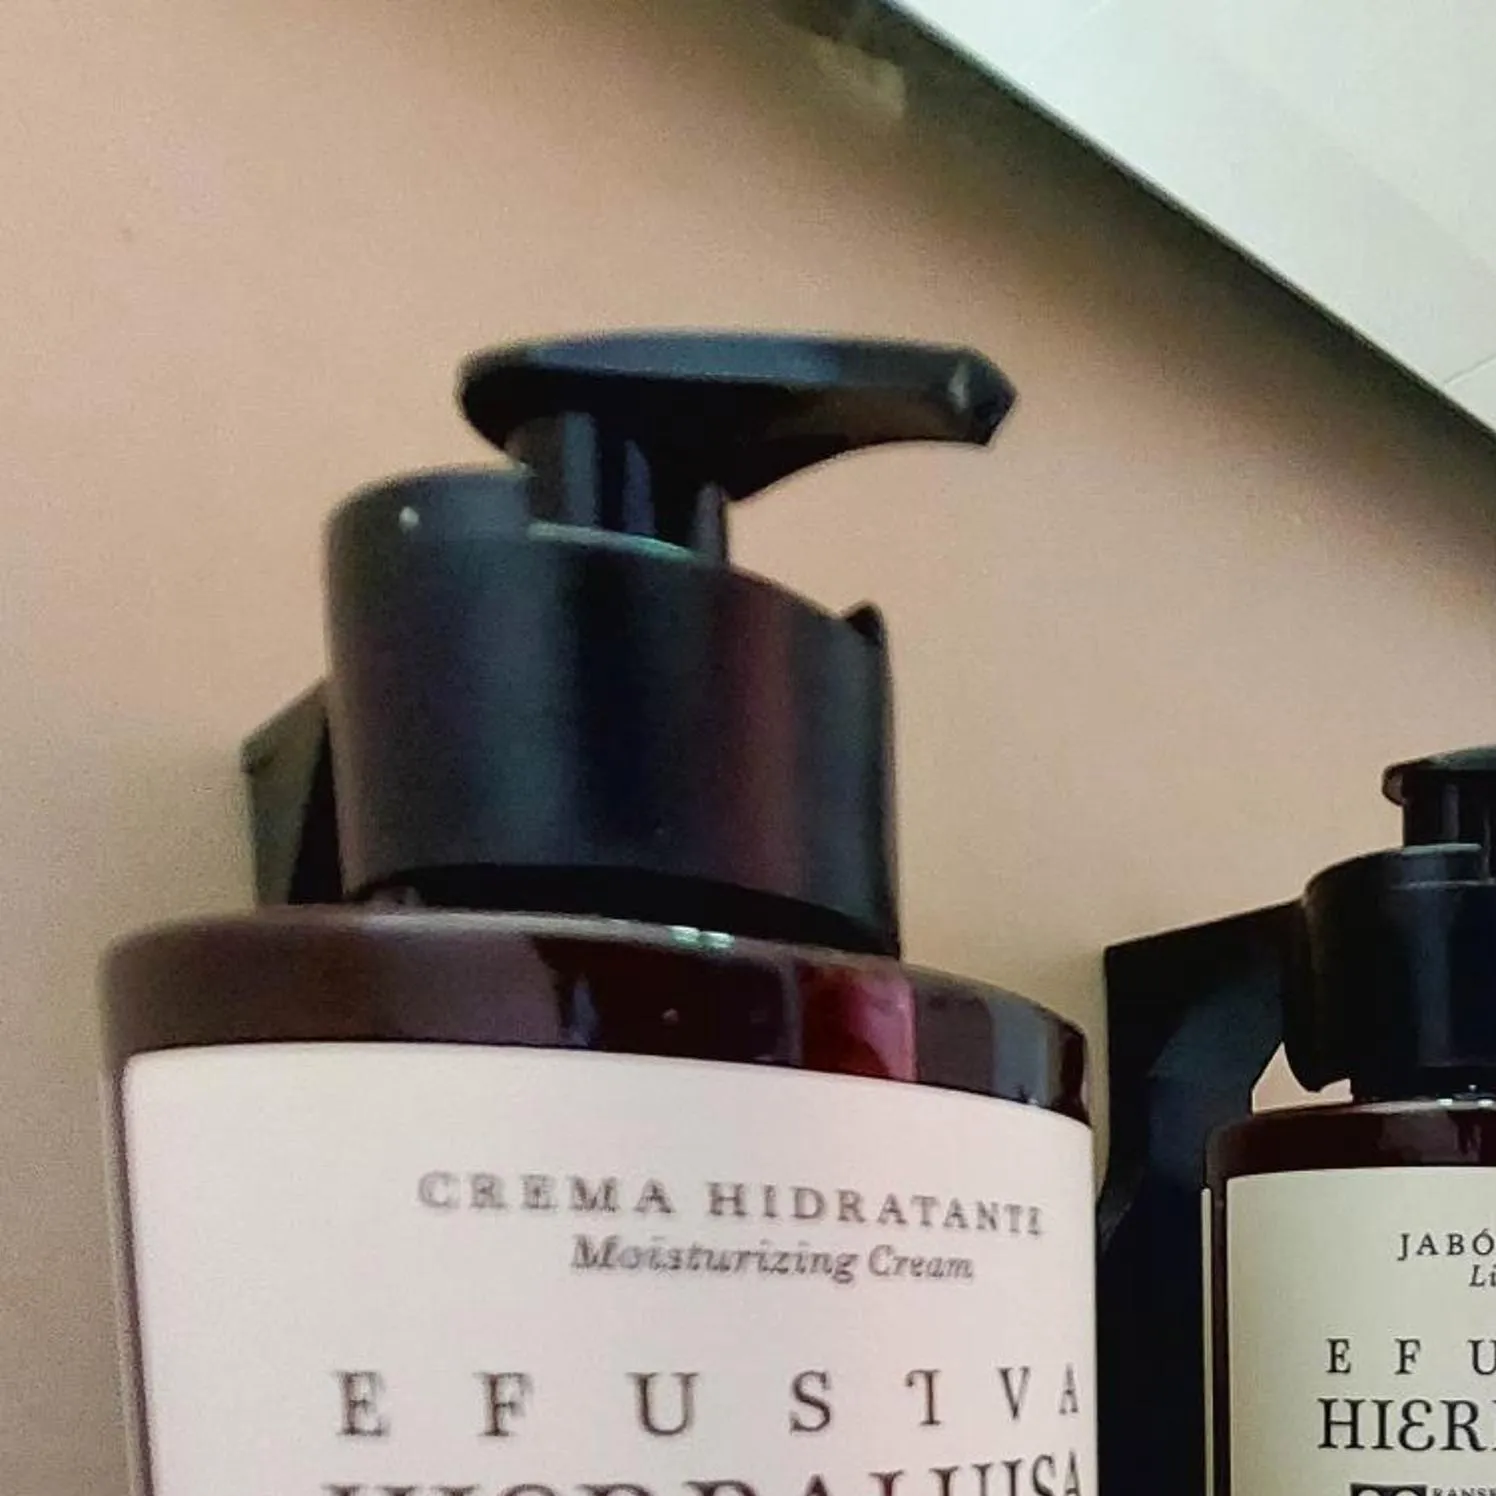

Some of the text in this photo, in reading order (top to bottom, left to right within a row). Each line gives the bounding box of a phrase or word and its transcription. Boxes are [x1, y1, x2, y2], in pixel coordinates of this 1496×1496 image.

[417, 1170, 1047, 1237] CREMA HIDRATANTE
[571, 1232, 975, 1284] Moisturizing Cream
